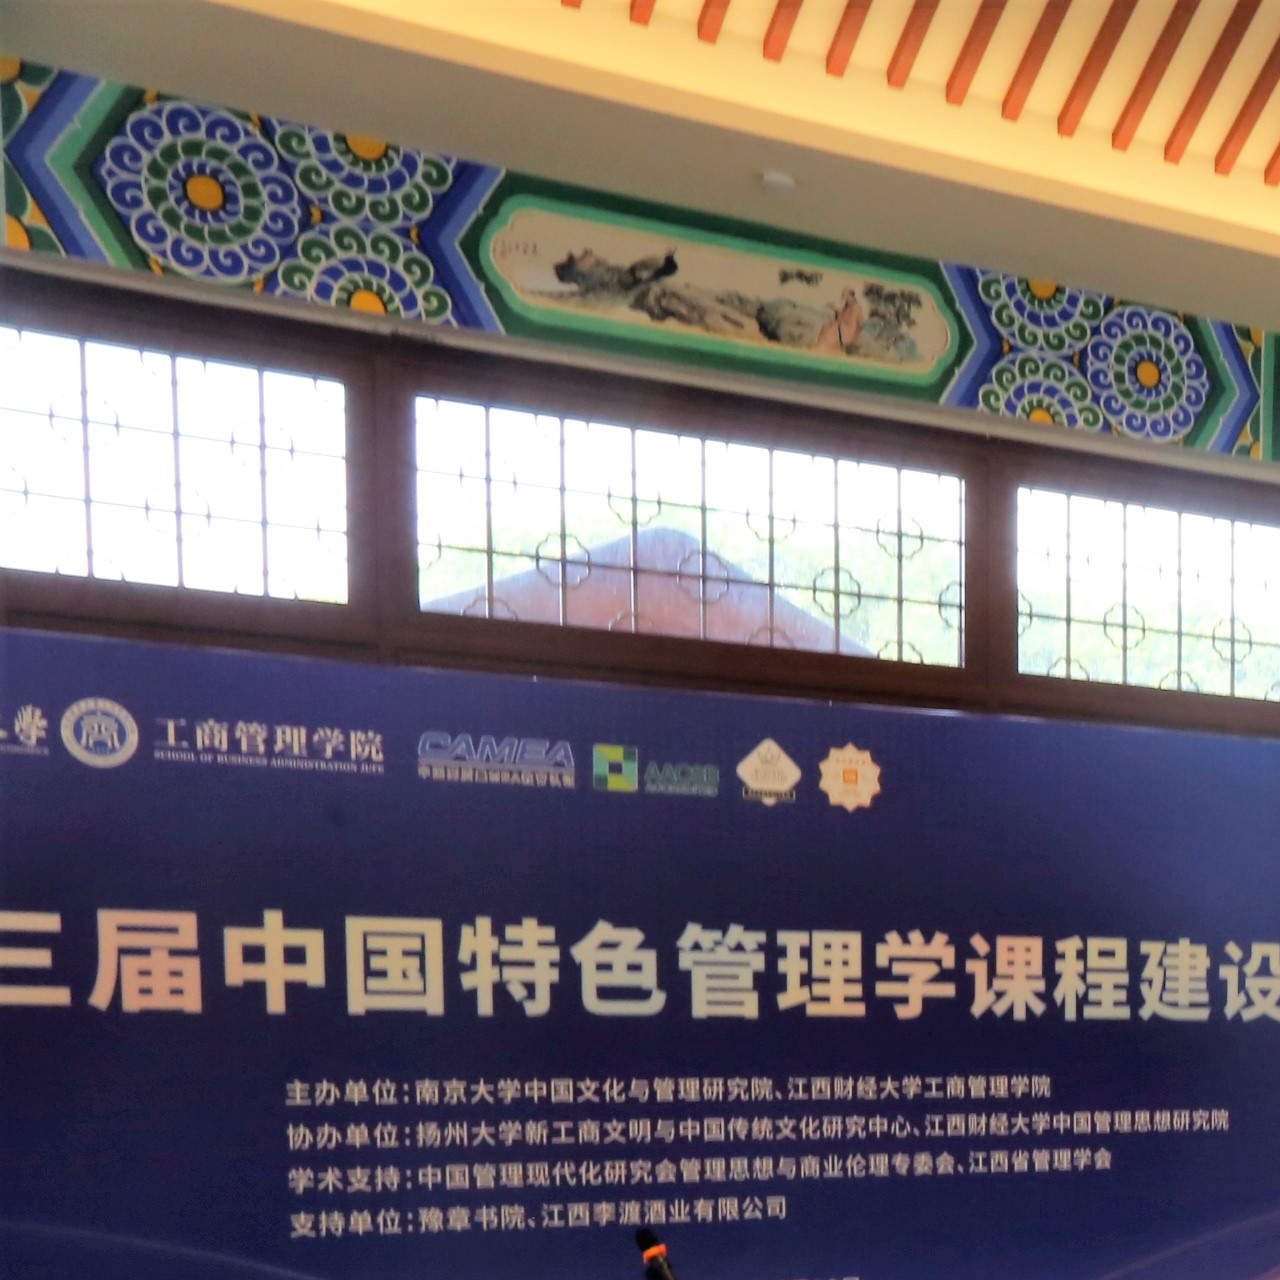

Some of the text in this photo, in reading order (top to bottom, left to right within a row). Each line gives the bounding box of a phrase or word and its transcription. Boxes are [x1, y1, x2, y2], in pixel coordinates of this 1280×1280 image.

[154, 716, 384, 762] 工商管理学院
[418, 731, 574, 767] CAMEA
